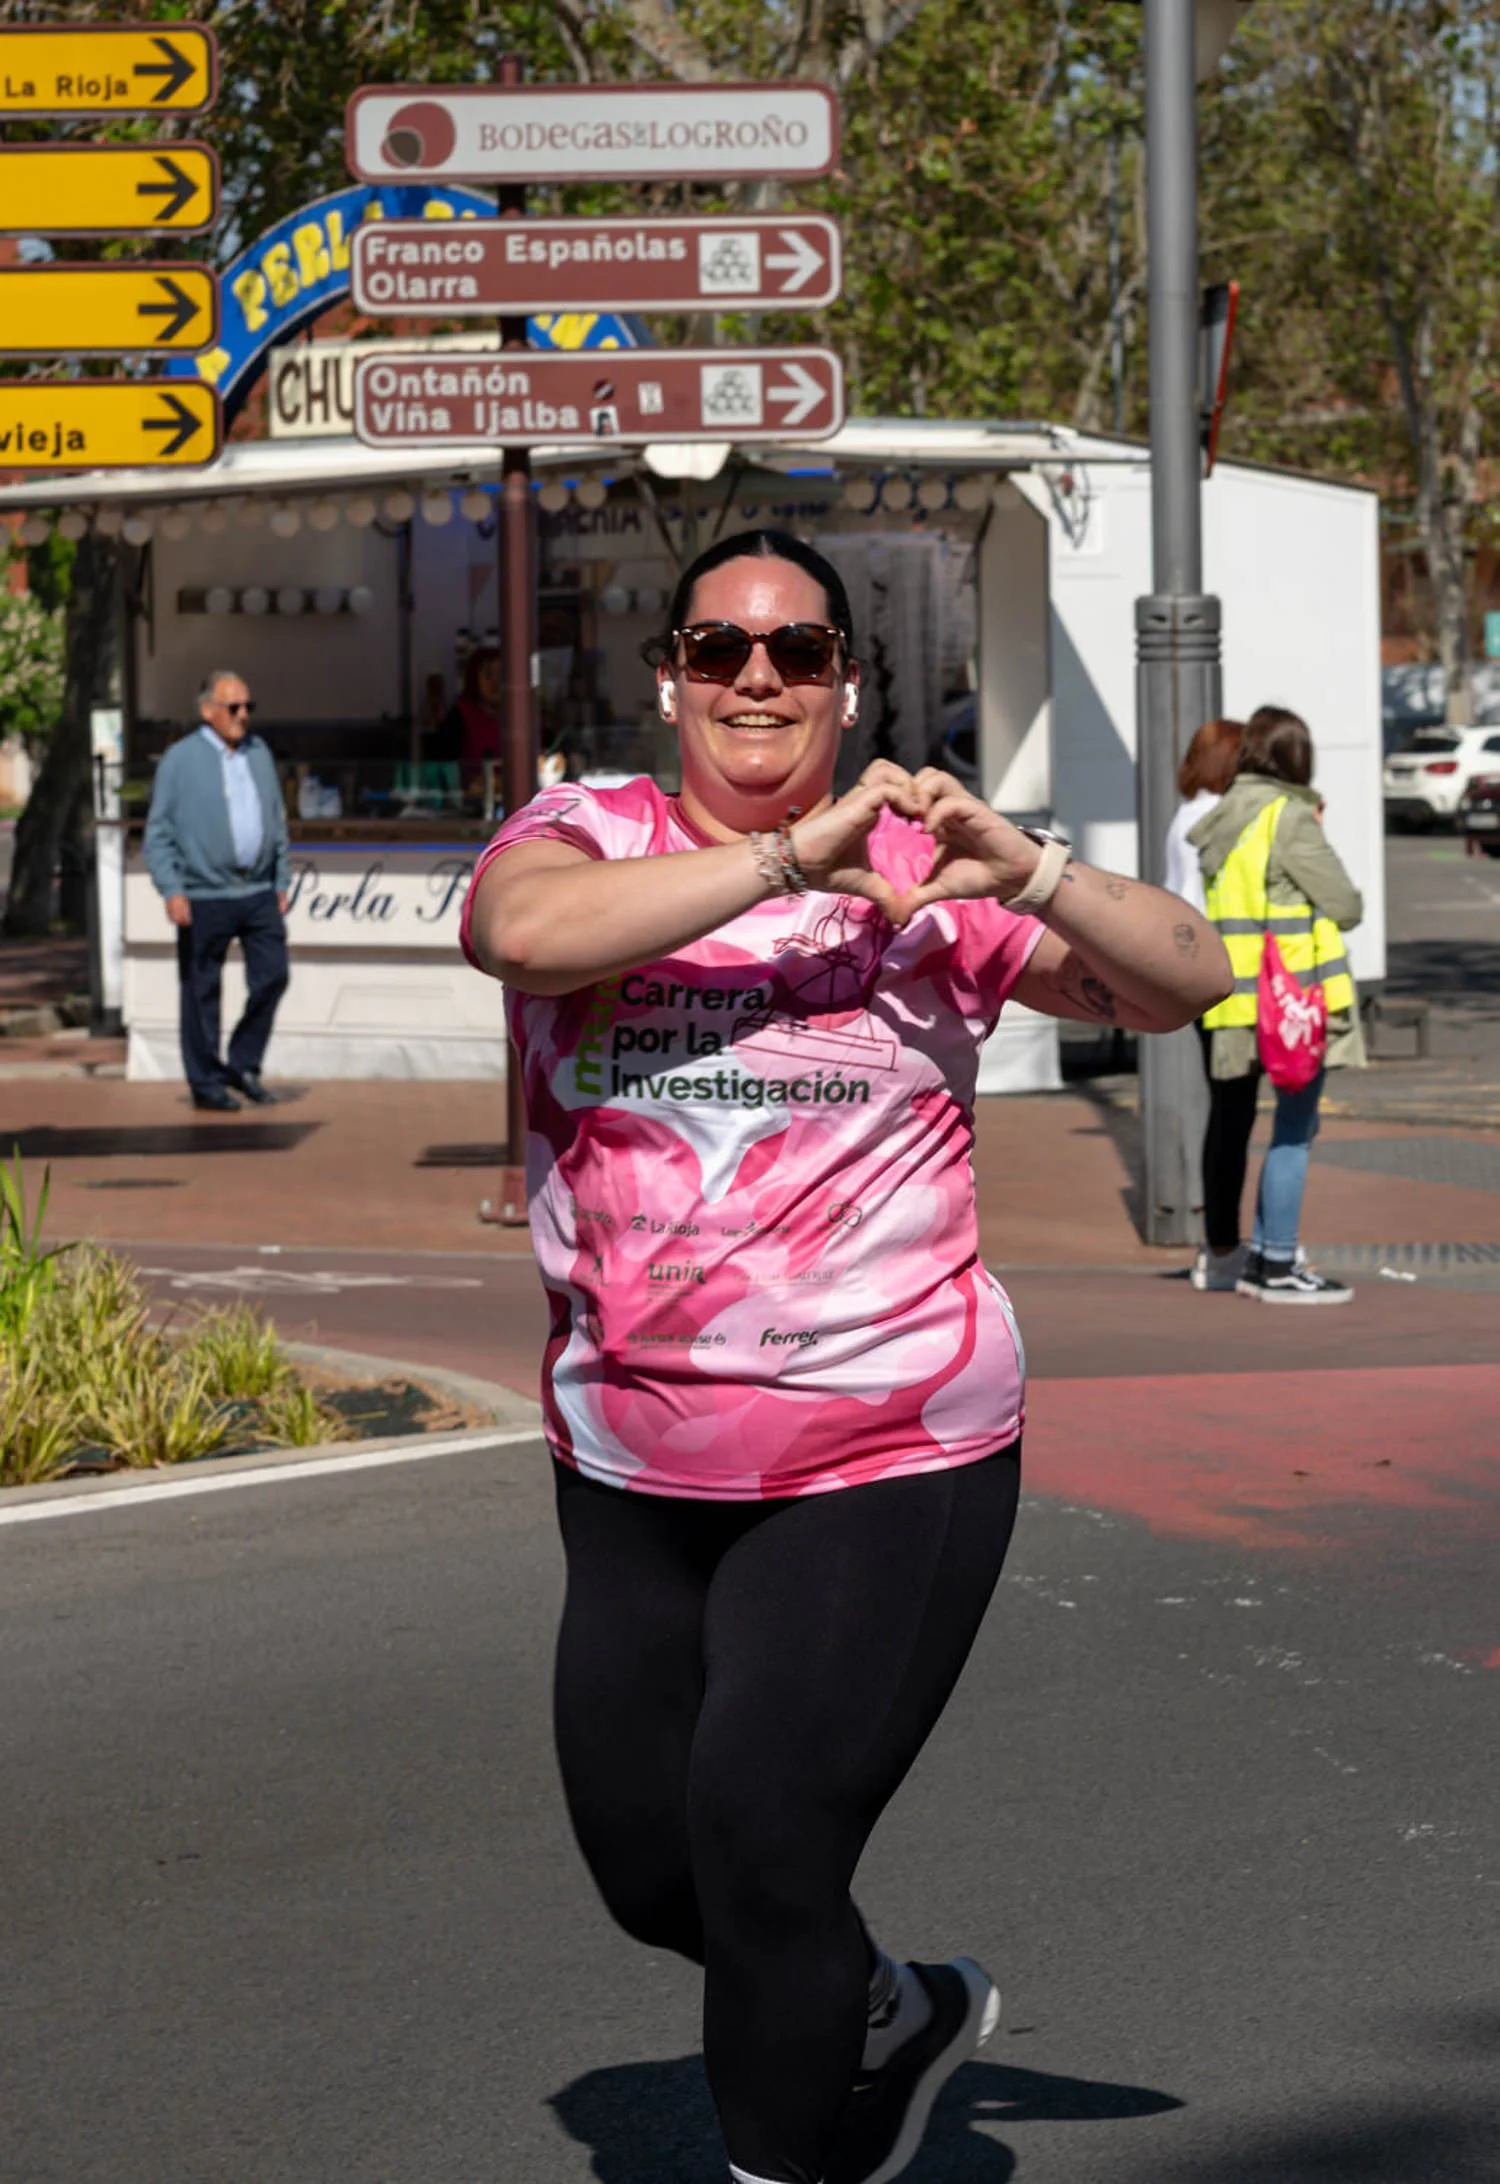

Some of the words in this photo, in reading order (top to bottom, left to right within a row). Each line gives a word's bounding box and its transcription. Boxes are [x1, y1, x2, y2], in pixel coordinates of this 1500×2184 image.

[5, 75, 36, 98] La
[56, 74, 128, 101] Rioja
[649, 114, 809, 148] LOGROÑO
[231, 201, 382, 333] PERL
[366, 236, 485, 265] Franco
[505, 232, 687, 269] Españolas
[367, 271, 478, 300] Olarra
[368, 364, 530, 397] Ontañón
[370, 402, 451, 432] Viña
[473, 400, 579, 437] Ijalba
[286, 856, 398, 922] Perla
[620, 973, 767, 1012] Carrera
[611, 1025, 678, 1060] por
[688, 1022, 722, 1056] la
[610, 1064, 871, 1109] Investigación
